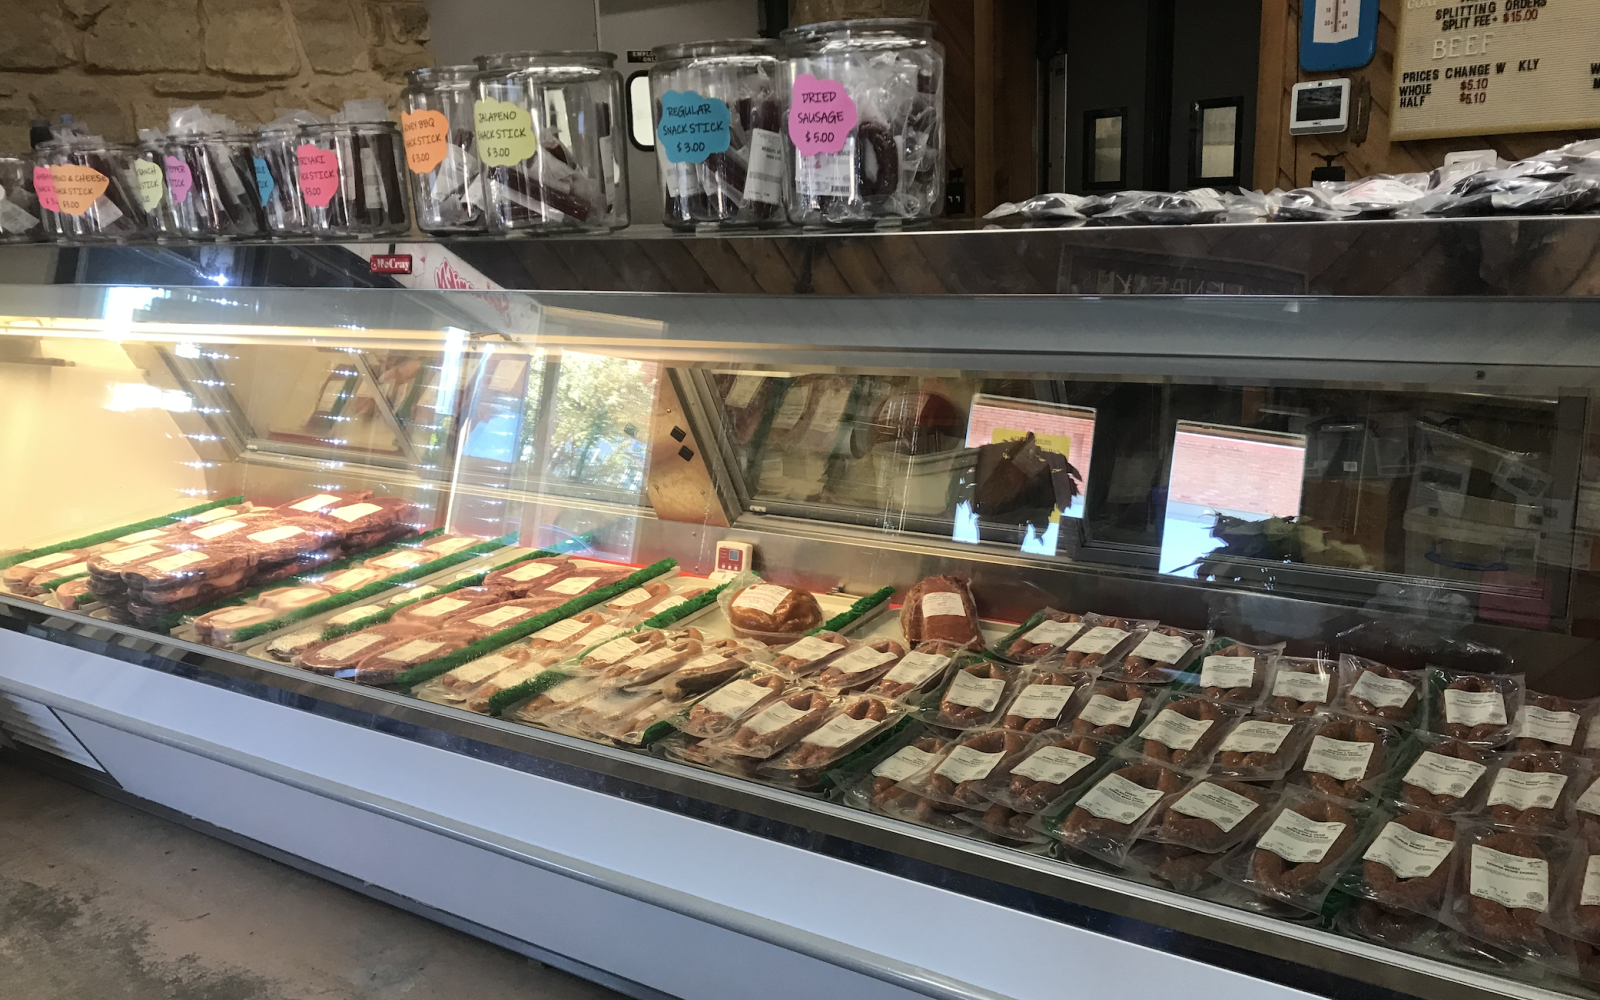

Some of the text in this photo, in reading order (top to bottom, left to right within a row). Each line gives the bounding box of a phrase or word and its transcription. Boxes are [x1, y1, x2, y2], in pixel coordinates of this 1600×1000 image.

[1435, 2, 1497, 21] SPLITTING
[1442, 8, 1538, 31] SPLIT FEE $15.00
[1432, 33, 1495, 60] BEEF
[1403, 69, 1440, 83] PRICES
[1445, 63, 1491, 79] CHANGE
[1399, 78, 1489, 97] WHOLE $5.10
[802, 91, 837, 104] DRIED
[1399, 92, 1487, 108] HALF $5.10
[478, 111, 517, 123] JALAPENO
[666, 104, 712, 117] REGULAR
[418, 117, 435, 129] BBQ
[797, 111, 844, 124] SAUSAGE
[495, 126, 526, 139] STICK
[662, 121, 724, 136] SNACK STICK
[417, 133, 442, 146] STICK
[805, 131, 835, 143] $5.00
[486, 147, 510, 158] $3.00
[676, 142, 705, 153] $3.00
[309, 169, 336, 180] STICK
[68, 187, 94, 196] STICK
